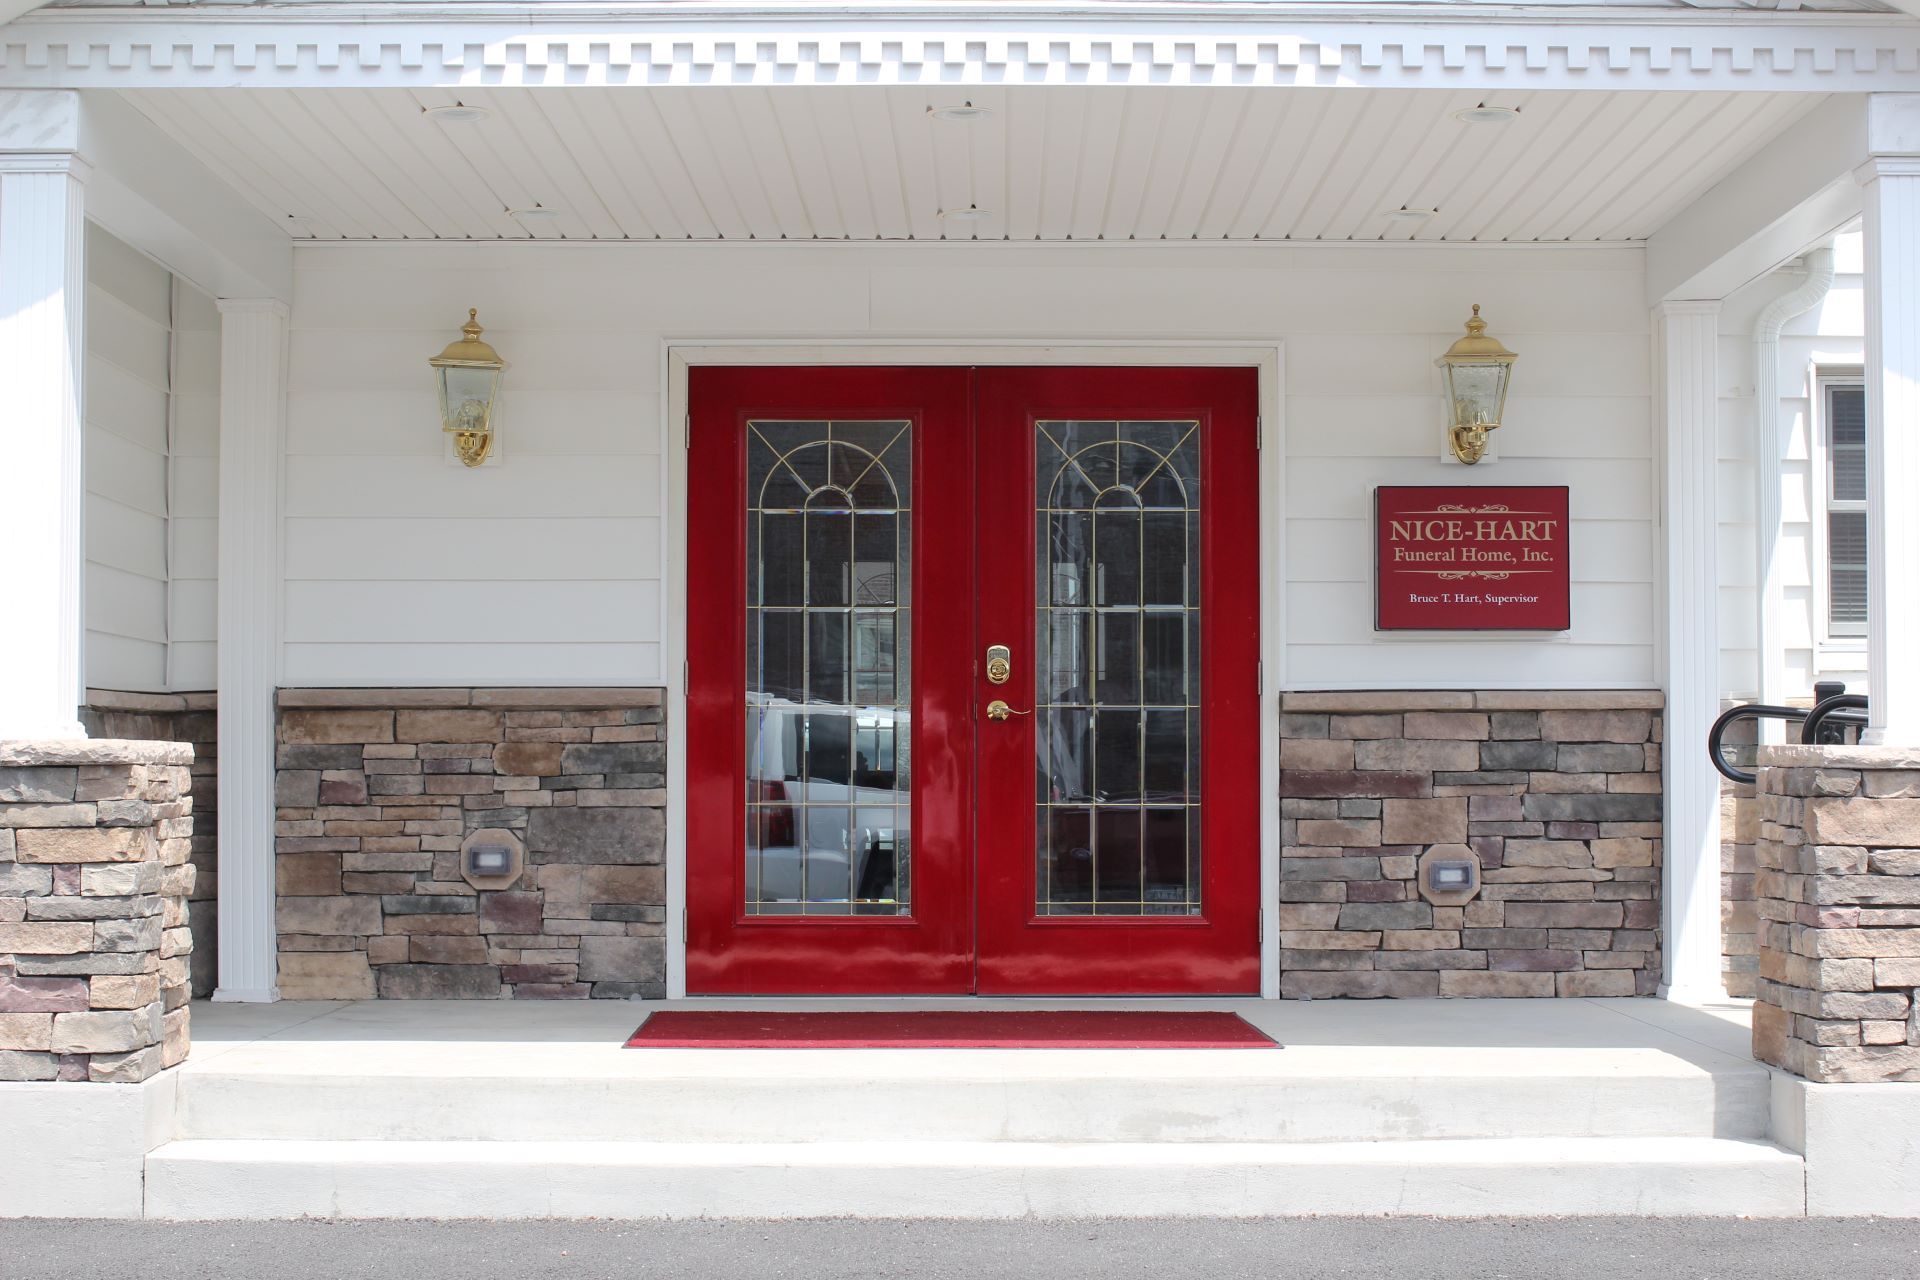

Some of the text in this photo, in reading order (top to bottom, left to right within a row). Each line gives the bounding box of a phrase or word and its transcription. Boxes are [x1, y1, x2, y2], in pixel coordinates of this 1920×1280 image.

[1389, 520, 1557, 541] NICE-HART
[1394, 547, 1553, 564] Funeral Home, Inc.
[1410, 593, 1538, 605] Bruce T. Hart, Supervisor
